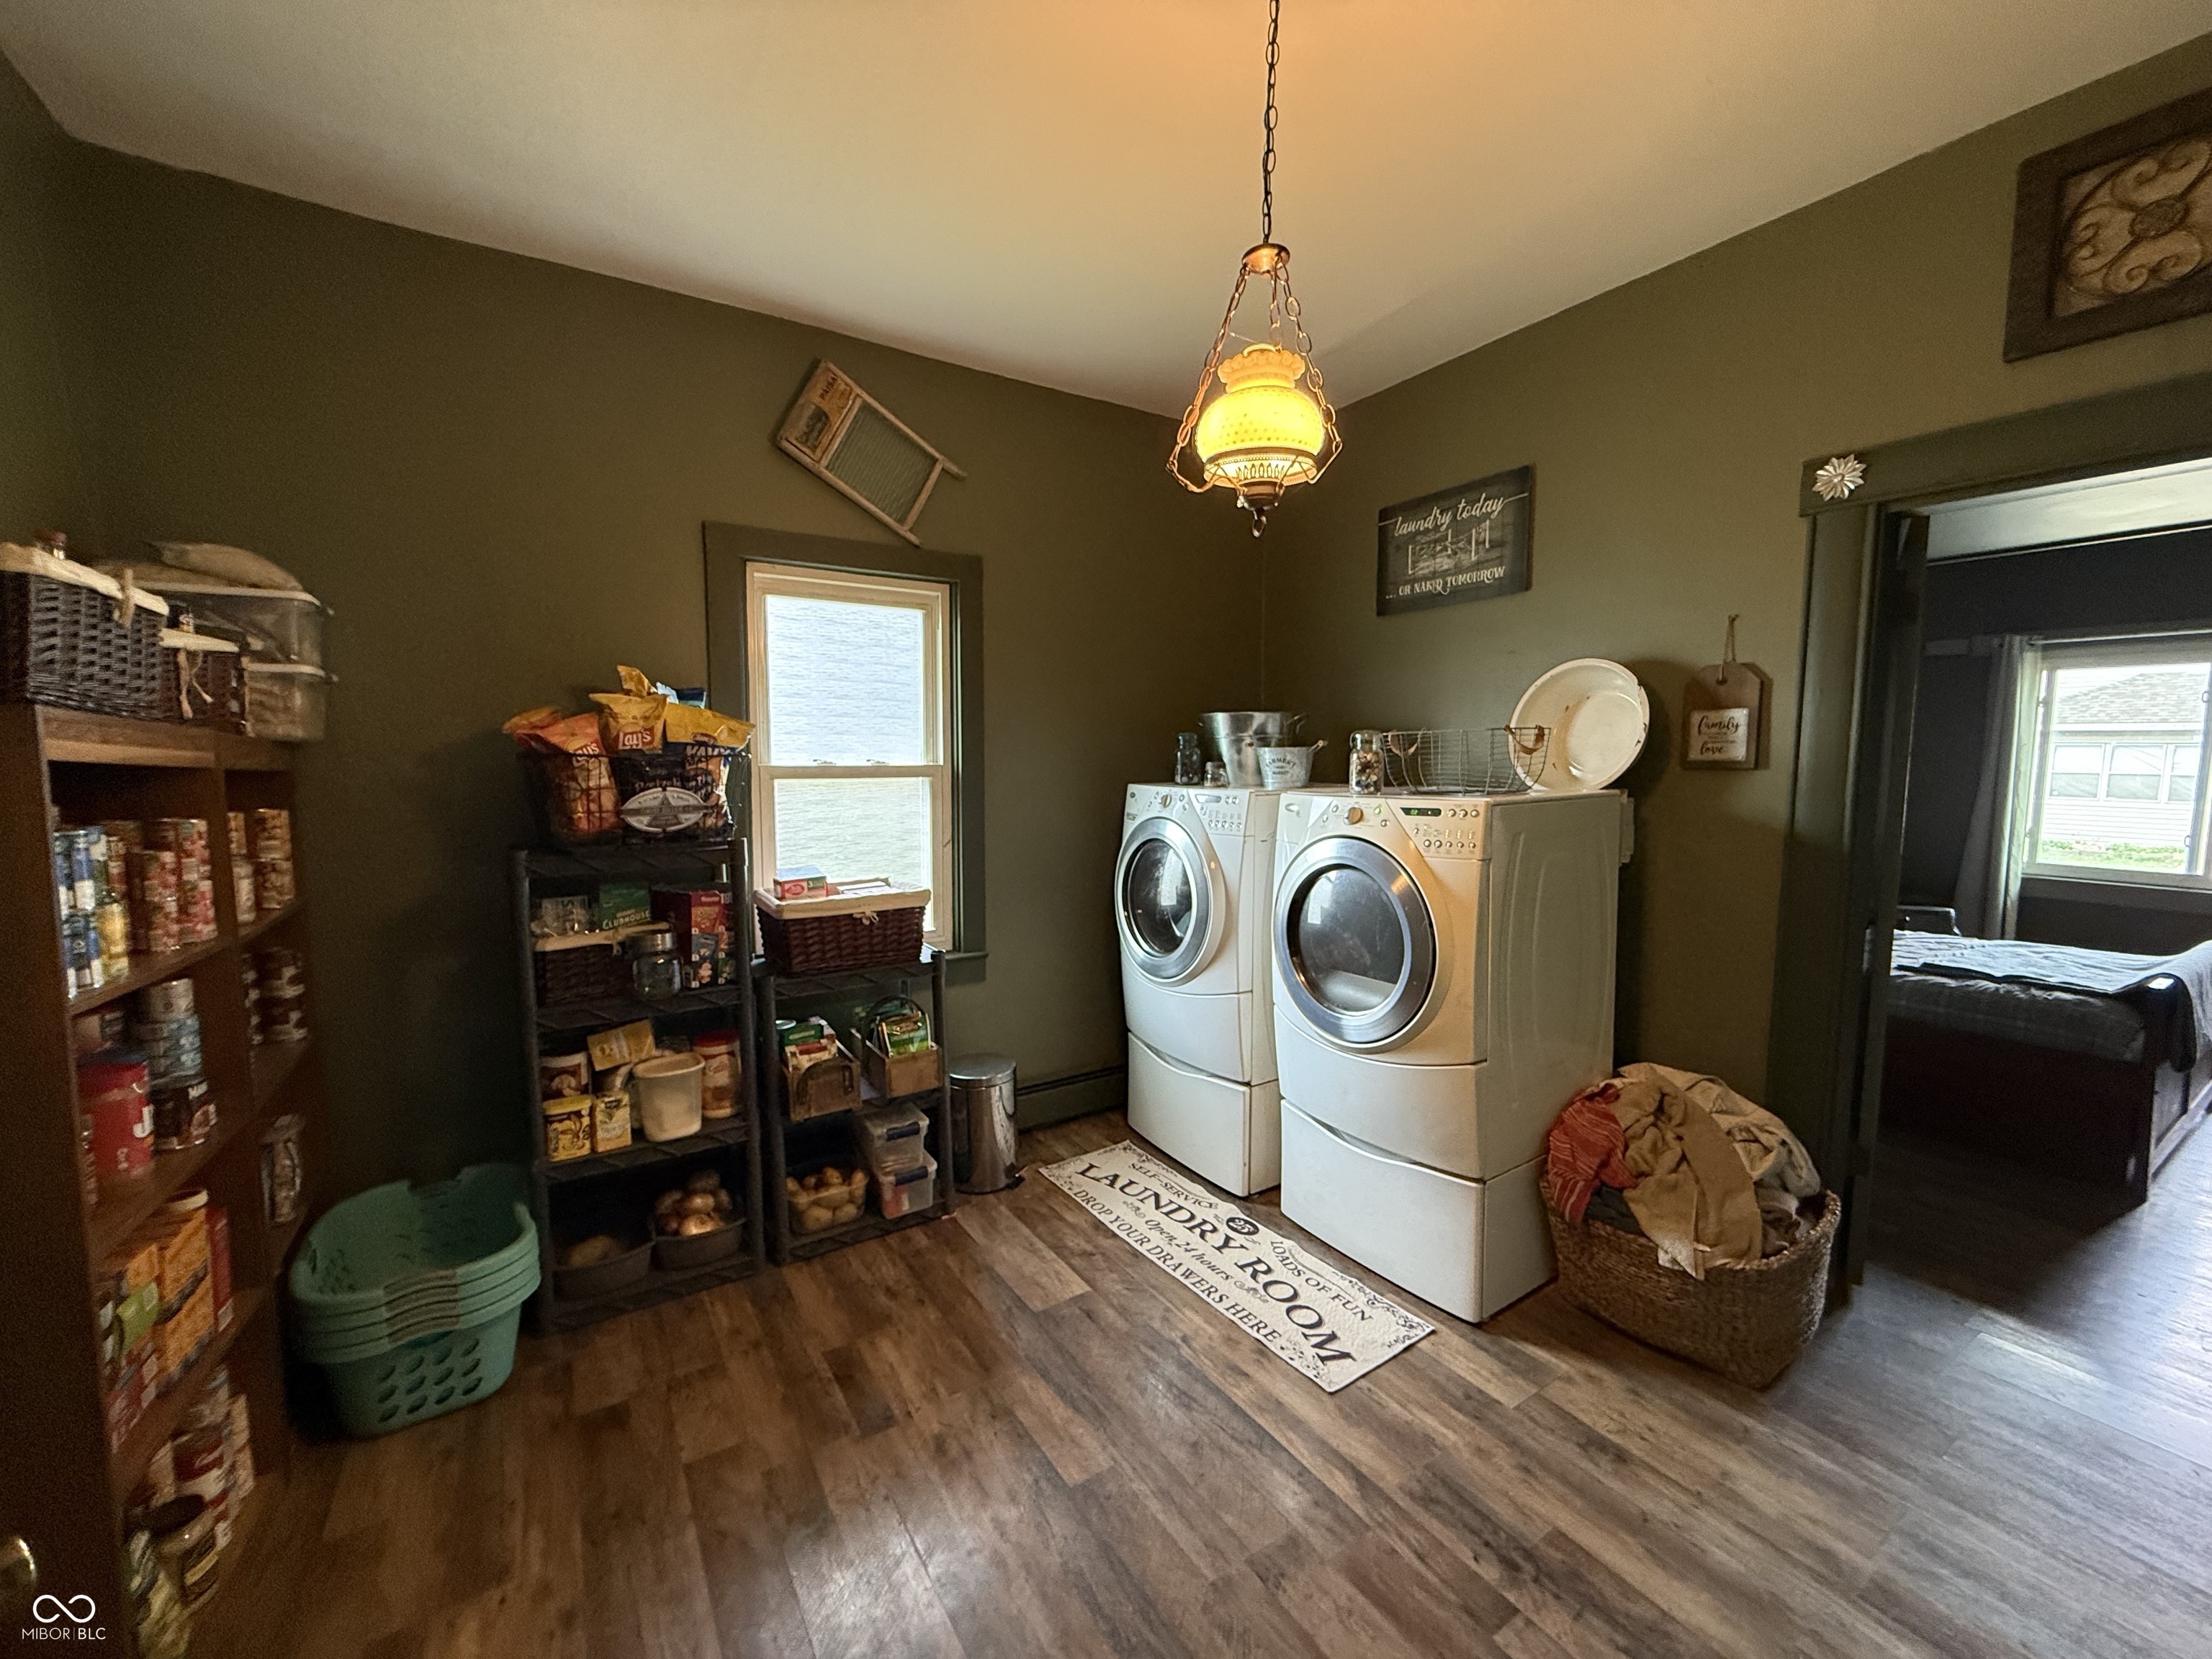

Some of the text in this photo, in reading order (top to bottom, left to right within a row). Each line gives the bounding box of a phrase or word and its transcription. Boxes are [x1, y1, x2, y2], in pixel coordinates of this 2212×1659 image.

[1394, 493, 1504, 536] laundry today
[1398, 584, 1411, 596] OR
[1413, 578, 1450, 595] NAKED
[1446, 566, 1506, 587] TOMORROW
[618, 727, 652, 750] Lay's
[1128, 1161, 1219, 1210] SELF-SERVICE
[1074, 1162, 1357, 1366] LAUNDRY ROOM
[1074, 1189, 1282, 1342] DROP YOUR DRAWERS HERE
[1145, 1219, 1234, 1281] Open 24 hours
[1270, 1240, 1374, 1321] LOADS OF FUN
